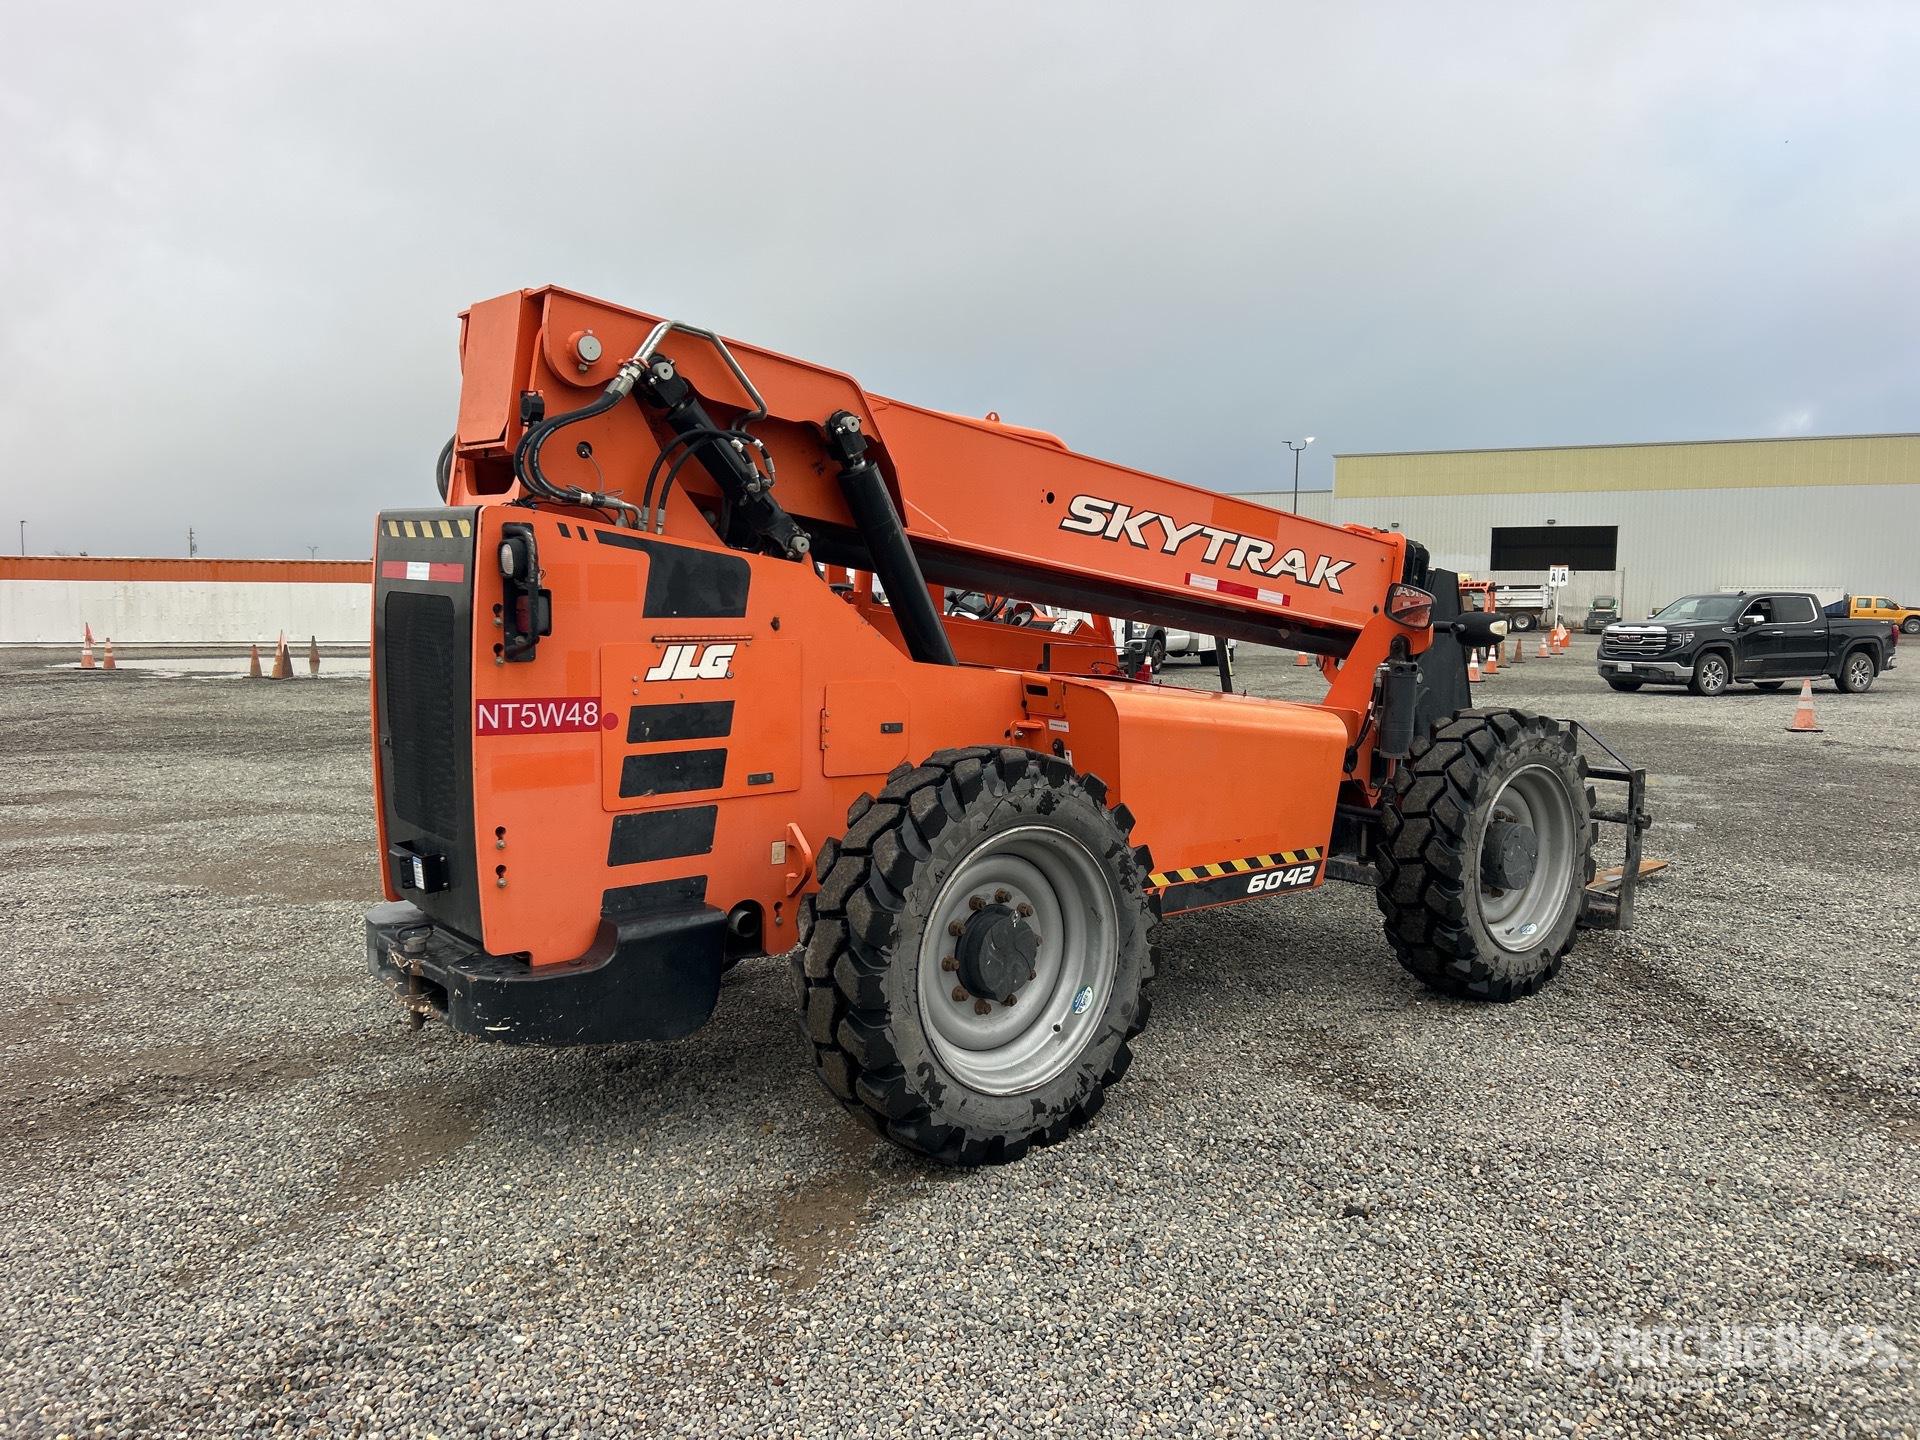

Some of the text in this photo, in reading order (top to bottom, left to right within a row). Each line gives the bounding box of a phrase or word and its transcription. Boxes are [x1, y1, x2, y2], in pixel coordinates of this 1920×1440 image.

[1059, 494, 1356, 594] SKYTRAK
[644, 643, 737, 682] JLG
[478, 701, 599, 729] NT5W48
[1247, 865, 1316, 893] 6042
